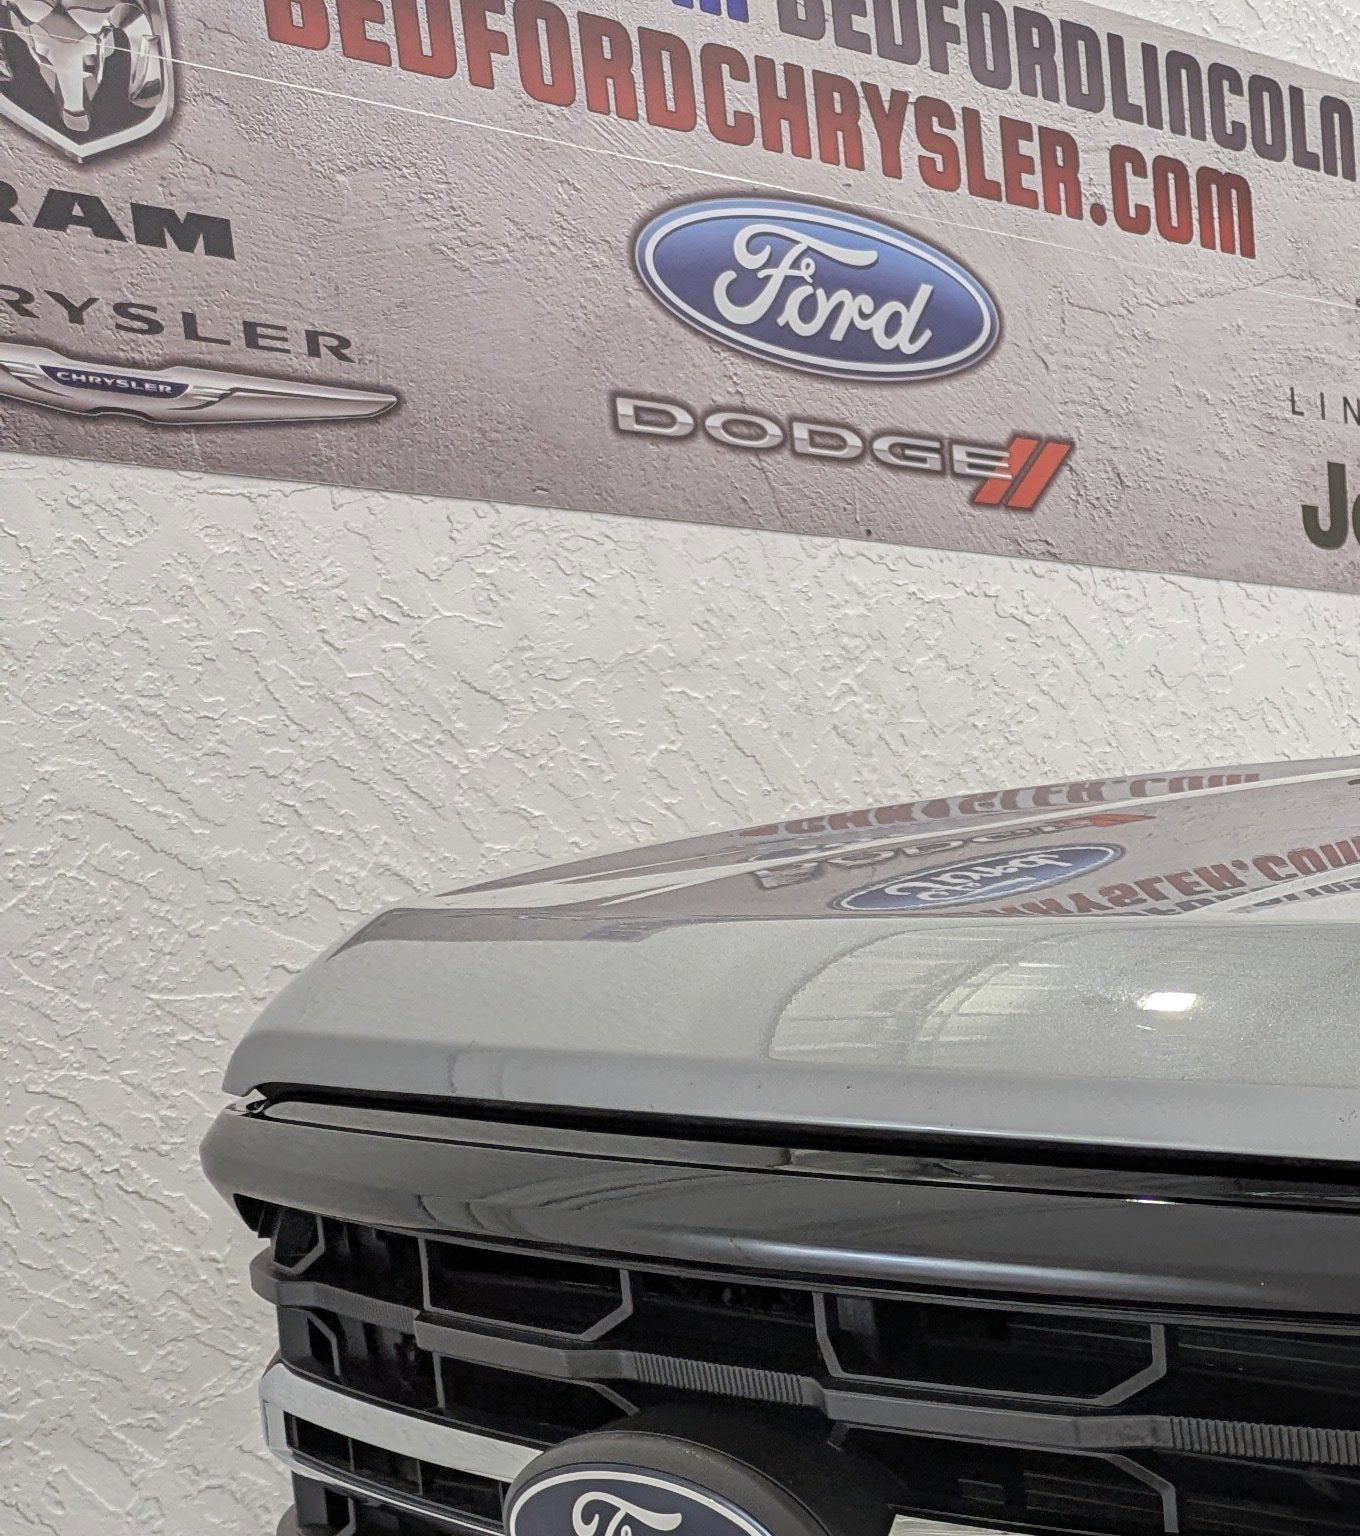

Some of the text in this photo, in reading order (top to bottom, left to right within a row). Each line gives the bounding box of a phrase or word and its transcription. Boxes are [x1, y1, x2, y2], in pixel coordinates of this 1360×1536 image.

[0, 180, 236, 260] AM
[712, 223, 934, 355] Ford
[55, 370, 174, 395] CHRYSLER
[614, 397, 1014, 482] DODGE
